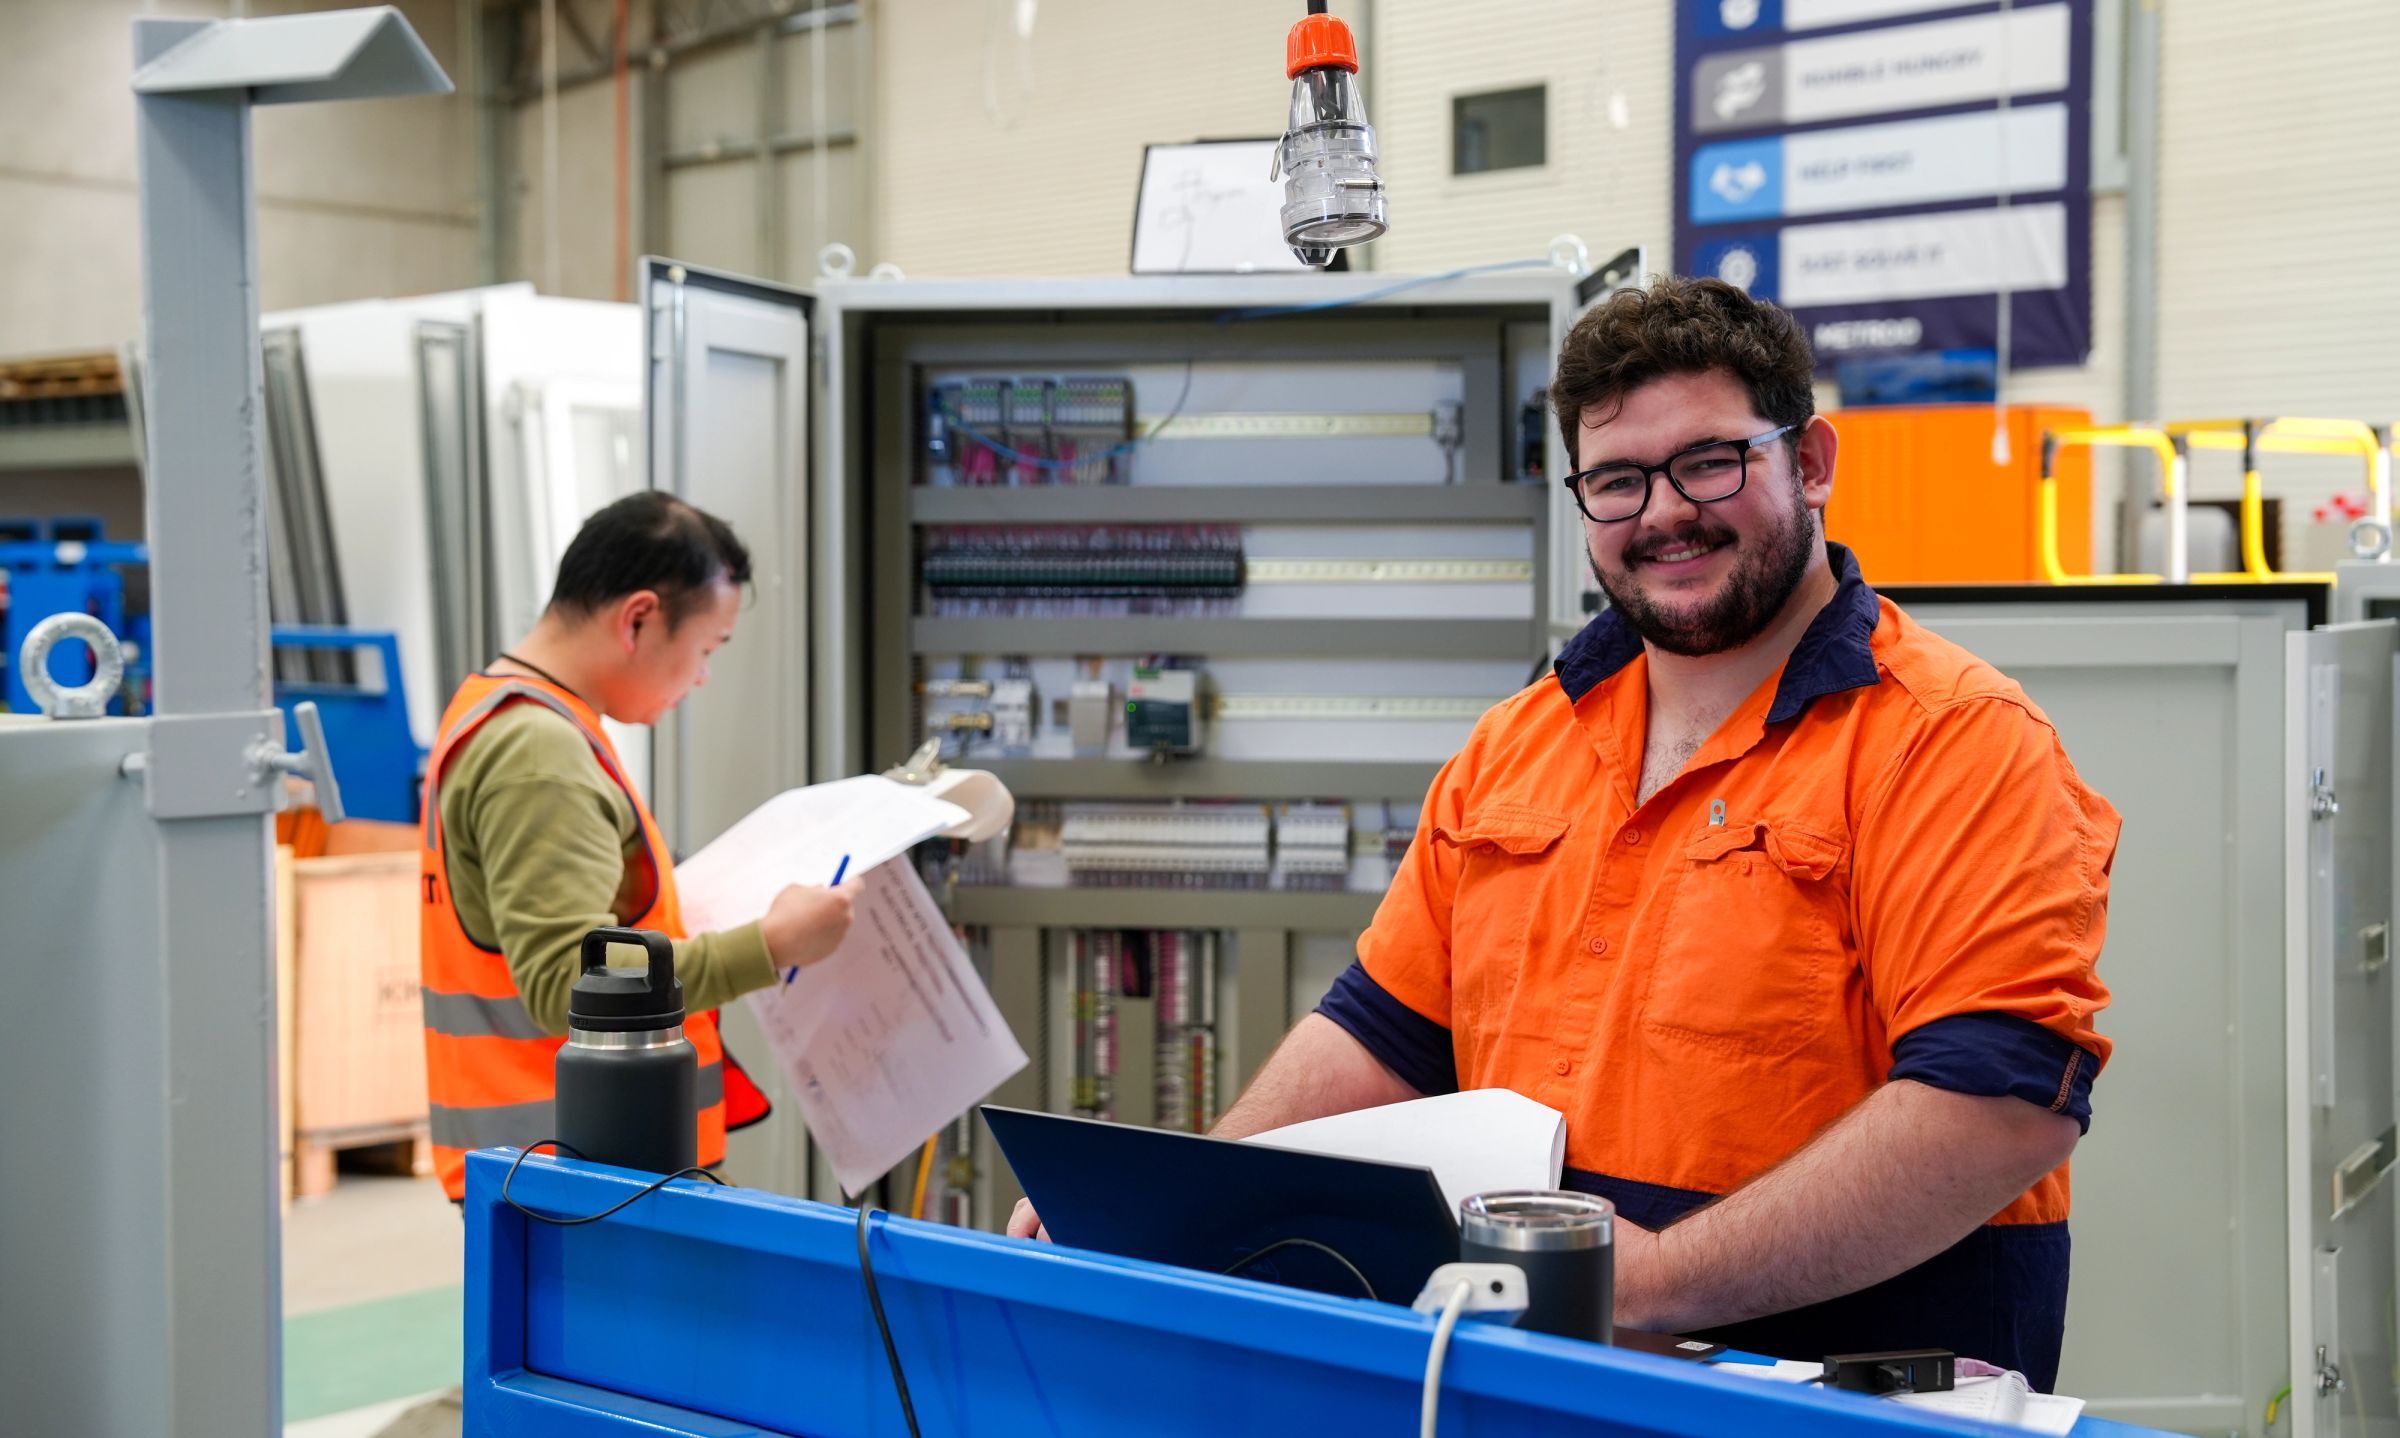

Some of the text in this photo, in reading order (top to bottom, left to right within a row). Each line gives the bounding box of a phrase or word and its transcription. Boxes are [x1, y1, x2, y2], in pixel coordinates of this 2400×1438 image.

[1892, 48, 1983, 78] HUNGRY
[1799, 151, 1913, 182] HELP FIRST
